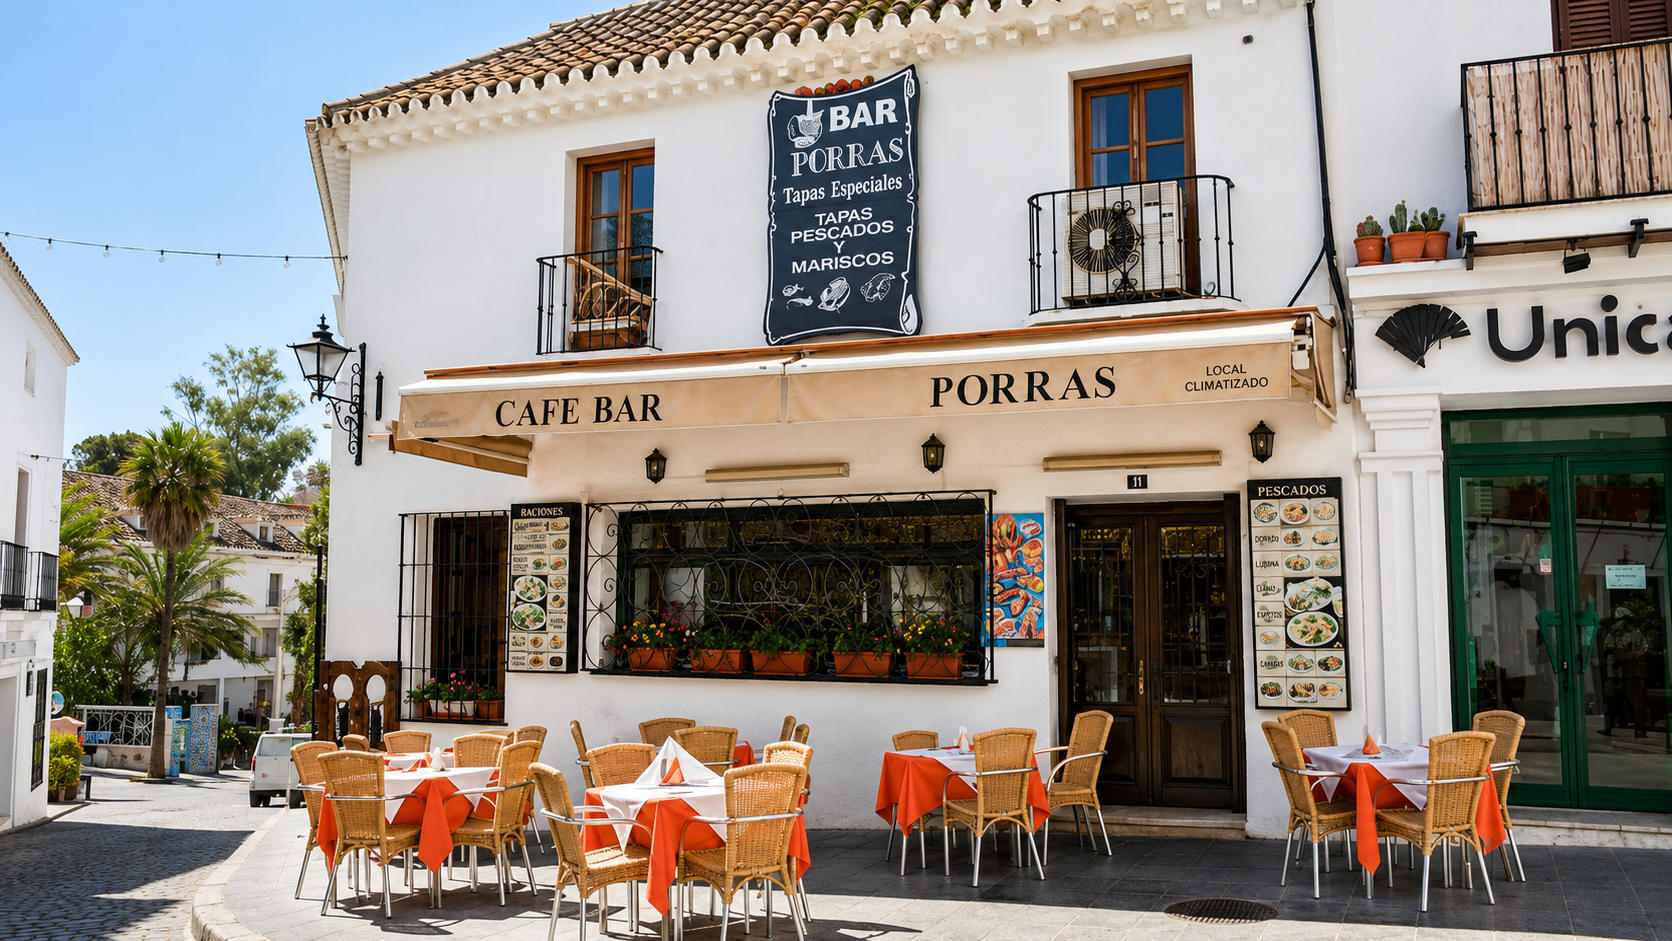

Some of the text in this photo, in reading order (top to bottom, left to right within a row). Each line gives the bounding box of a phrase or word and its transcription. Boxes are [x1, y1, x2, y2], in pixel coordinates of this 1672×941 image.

[829, 98, 898, 133] BAR
[790, 137, 904, 178] PORRAS
[783, 174, 903, 206] Tapas Especiales
[815, 207, 873, 226] TAPAS
[791, 220, 894, 244] PESCADOS
[833, 240, 845, 254] Y
[792, 251, 894, 274] MARISCOS
[1486, 294, 1672, 363] Unic
[1206, 363, 1247, 377] LOCAL
[930, 366, 1116, 408] PORRAS
[1185, 377, 1269, 393] CLIMATIZADO
[495, 398, 580, 428] CAFE
[592, 393, 663, 424] BAR
[1133, 476, 1142, 488] 11
[1258, 484, 1327, 497] PESCADOS
[520, 507, 564, 517] RACIONES
